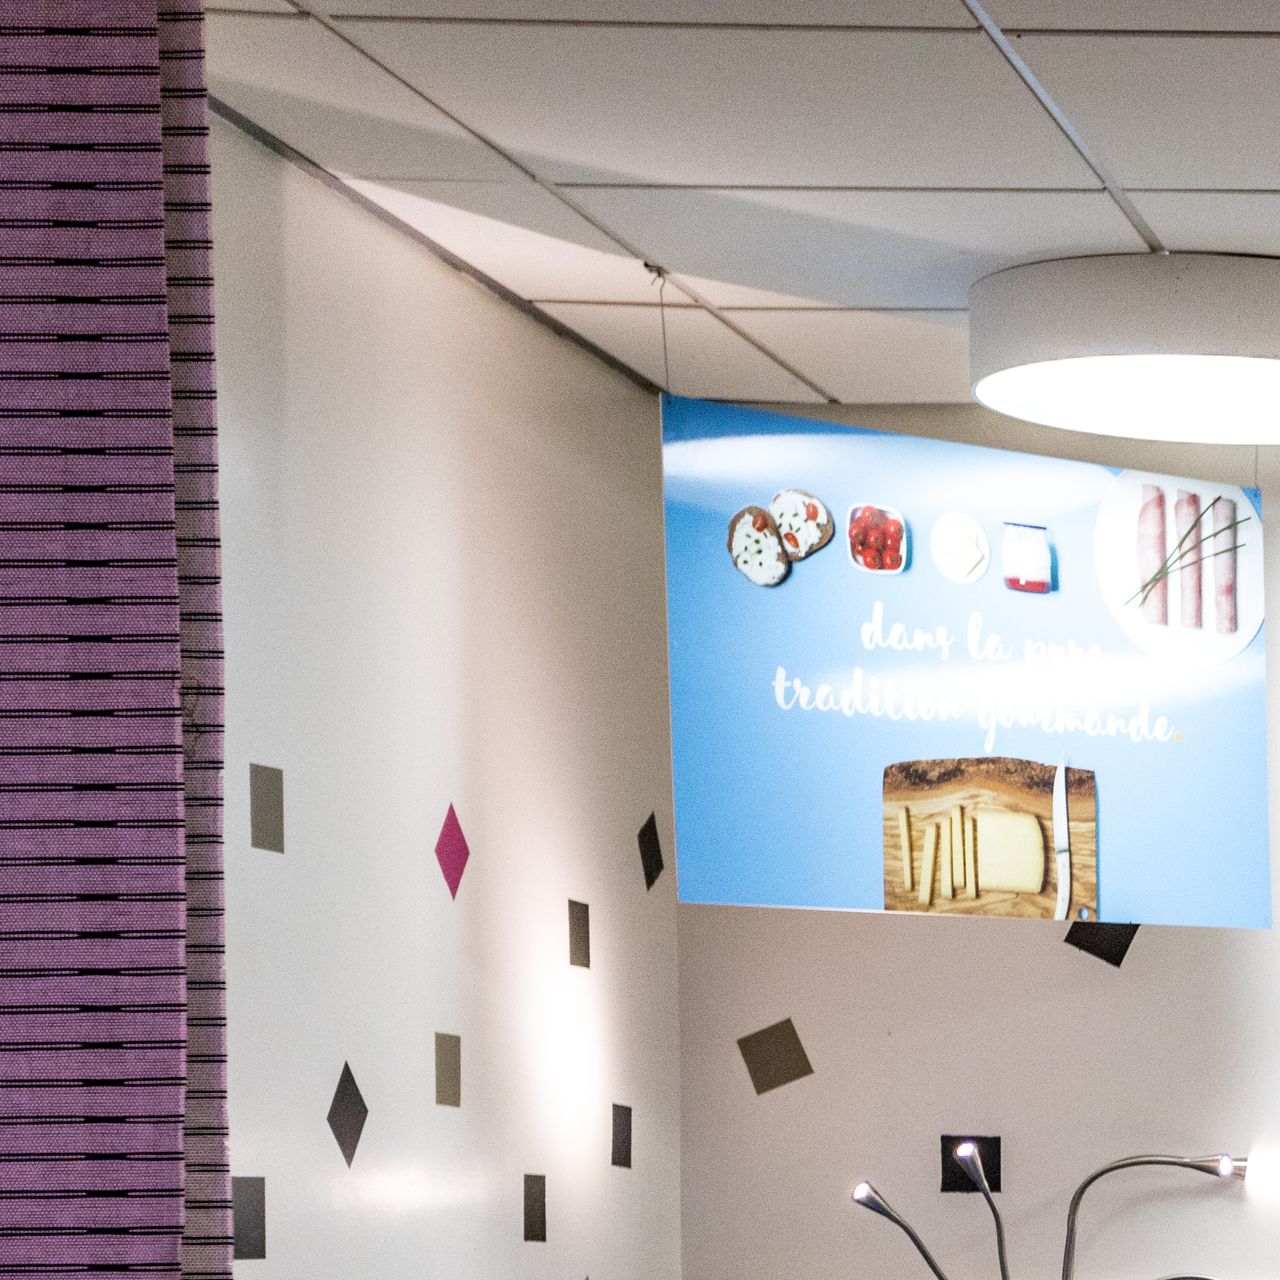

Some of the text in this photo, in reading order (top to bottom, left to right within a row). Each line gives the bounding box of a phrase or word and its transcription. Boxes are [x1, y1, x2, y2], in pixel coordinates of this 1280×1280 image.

[860, 599, 955, 661] dans
[966, 610, 1015, 662] la
[771, 665, 965, 722] tradition
